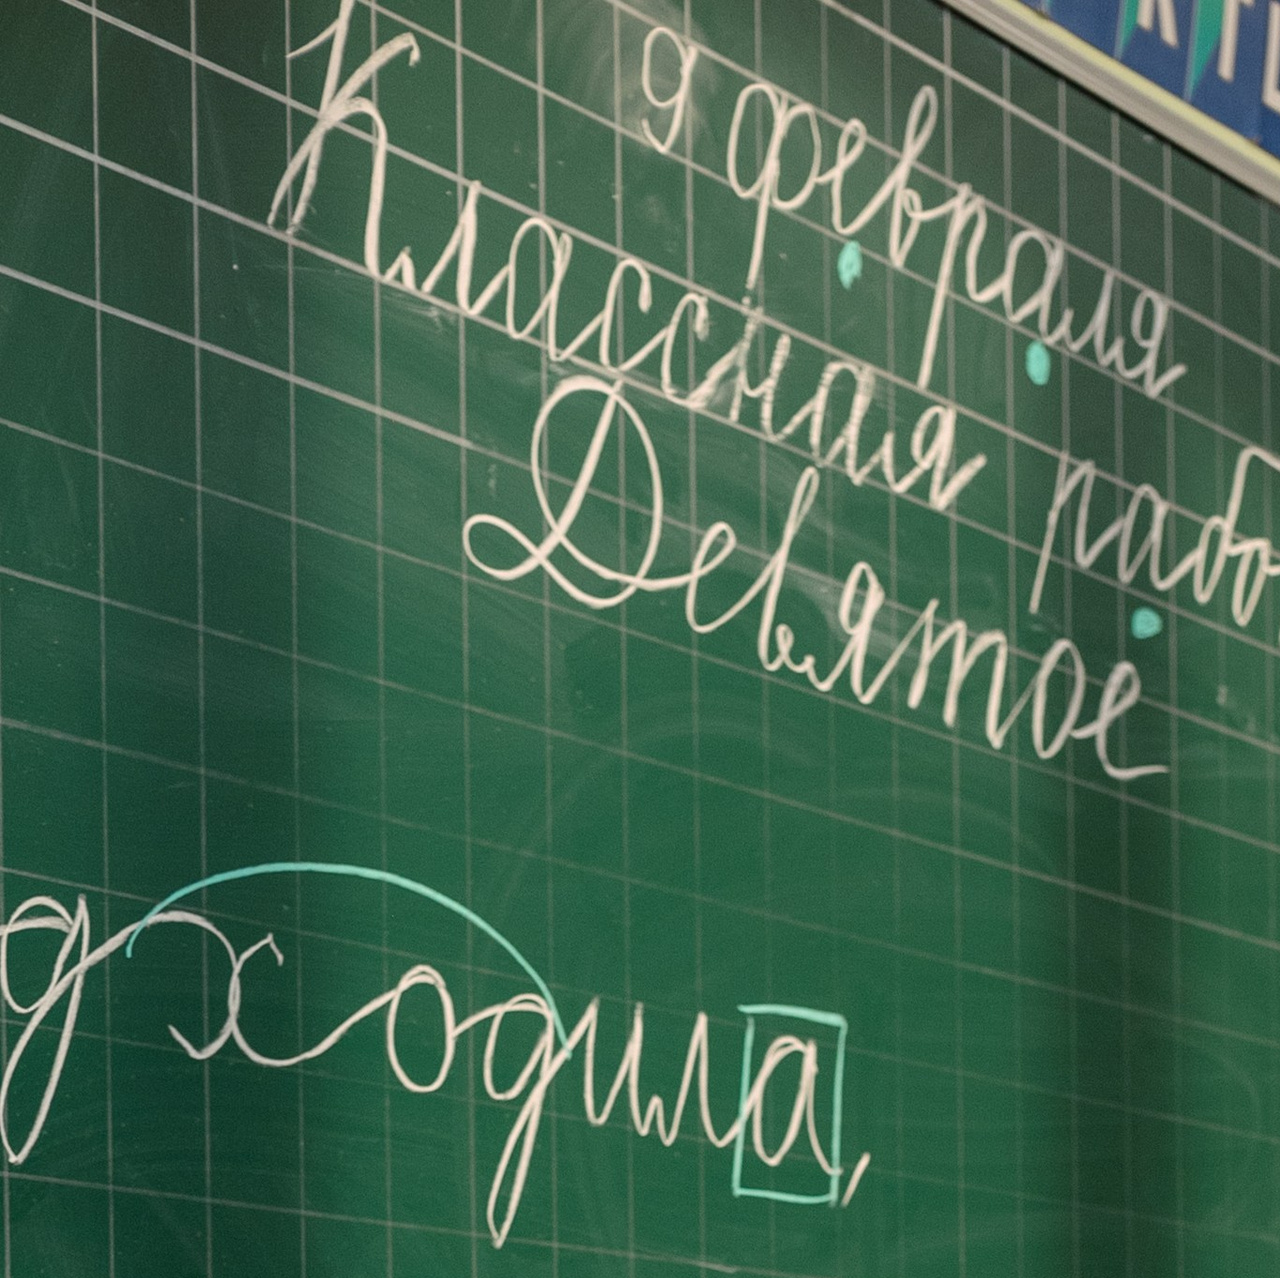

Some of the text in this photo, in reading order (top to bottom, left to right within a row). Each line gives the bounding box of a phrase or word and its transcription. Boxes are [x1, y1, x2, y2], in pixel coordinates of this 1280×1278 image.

[267, 0, 986, 509] Классная
[640, 26, 1187, 398] 9 февраля
[463, 376, 1169, 781] Девятое
